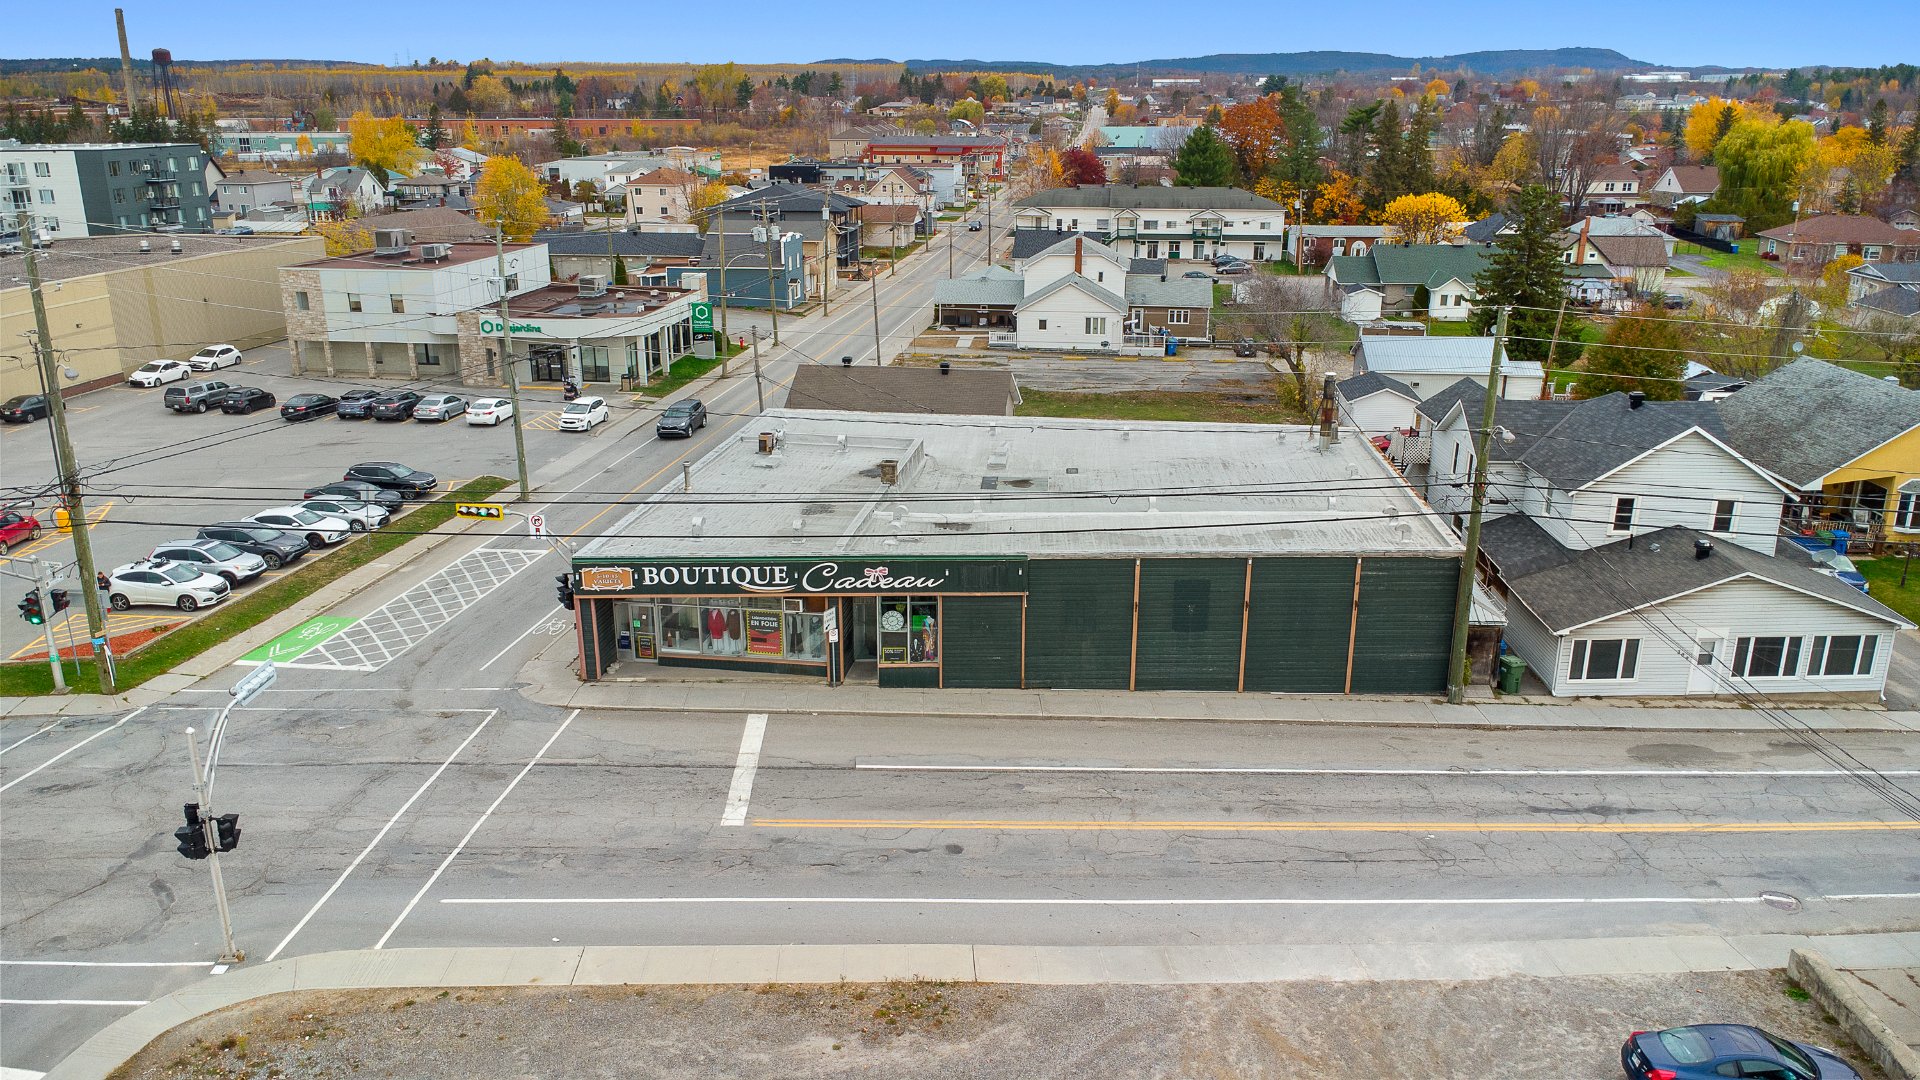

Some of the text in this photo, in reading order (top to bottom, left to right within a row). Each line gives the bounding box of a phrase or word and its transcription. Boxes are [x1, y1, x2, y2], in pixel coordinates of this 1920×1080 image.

[496, 323, 541, 333] Dsjardins
[641, 562, 944, 592] BOUTIQUE Cadeau
